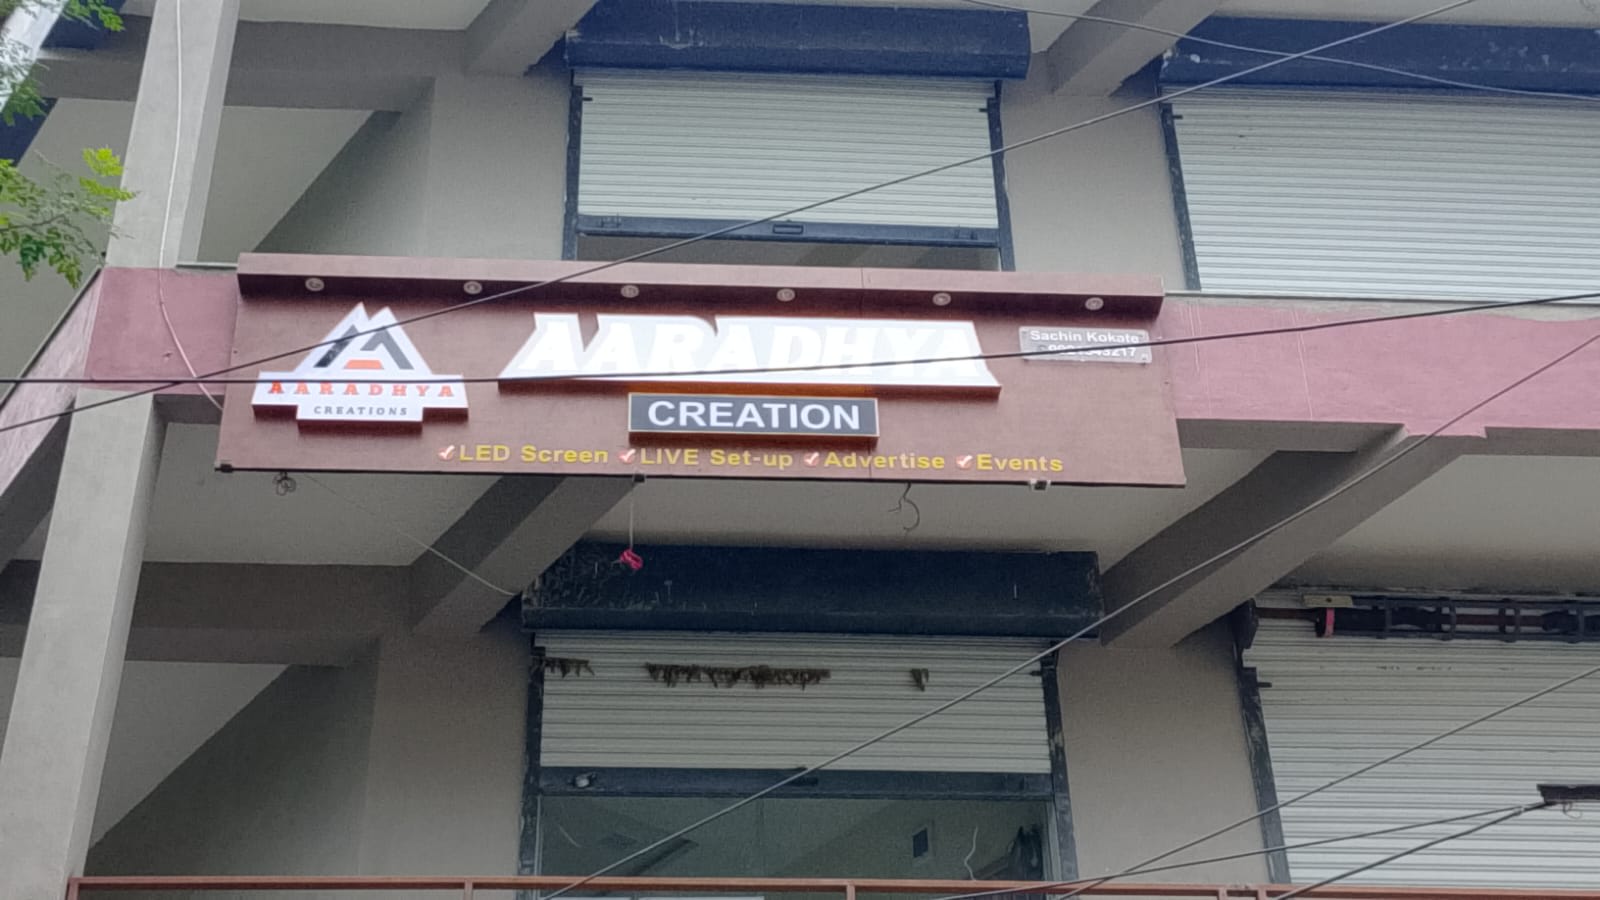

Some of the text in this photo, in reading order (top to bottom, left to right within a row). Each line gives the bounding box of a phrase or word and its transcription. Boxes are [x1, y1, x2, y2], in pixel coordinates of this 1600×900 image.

[1030, 330, 1140, 344] Sachin Kokate
[516, 320, 979, 377] AARADHYA
[268, 380, 454, 397] AARADHYA
[314, 405, 408, 416] CREATIONS
[647, 400, 861, 430] CREATION
[459, 445, 1064, 472] LED Screen LIVE Set-up Advertise Events
